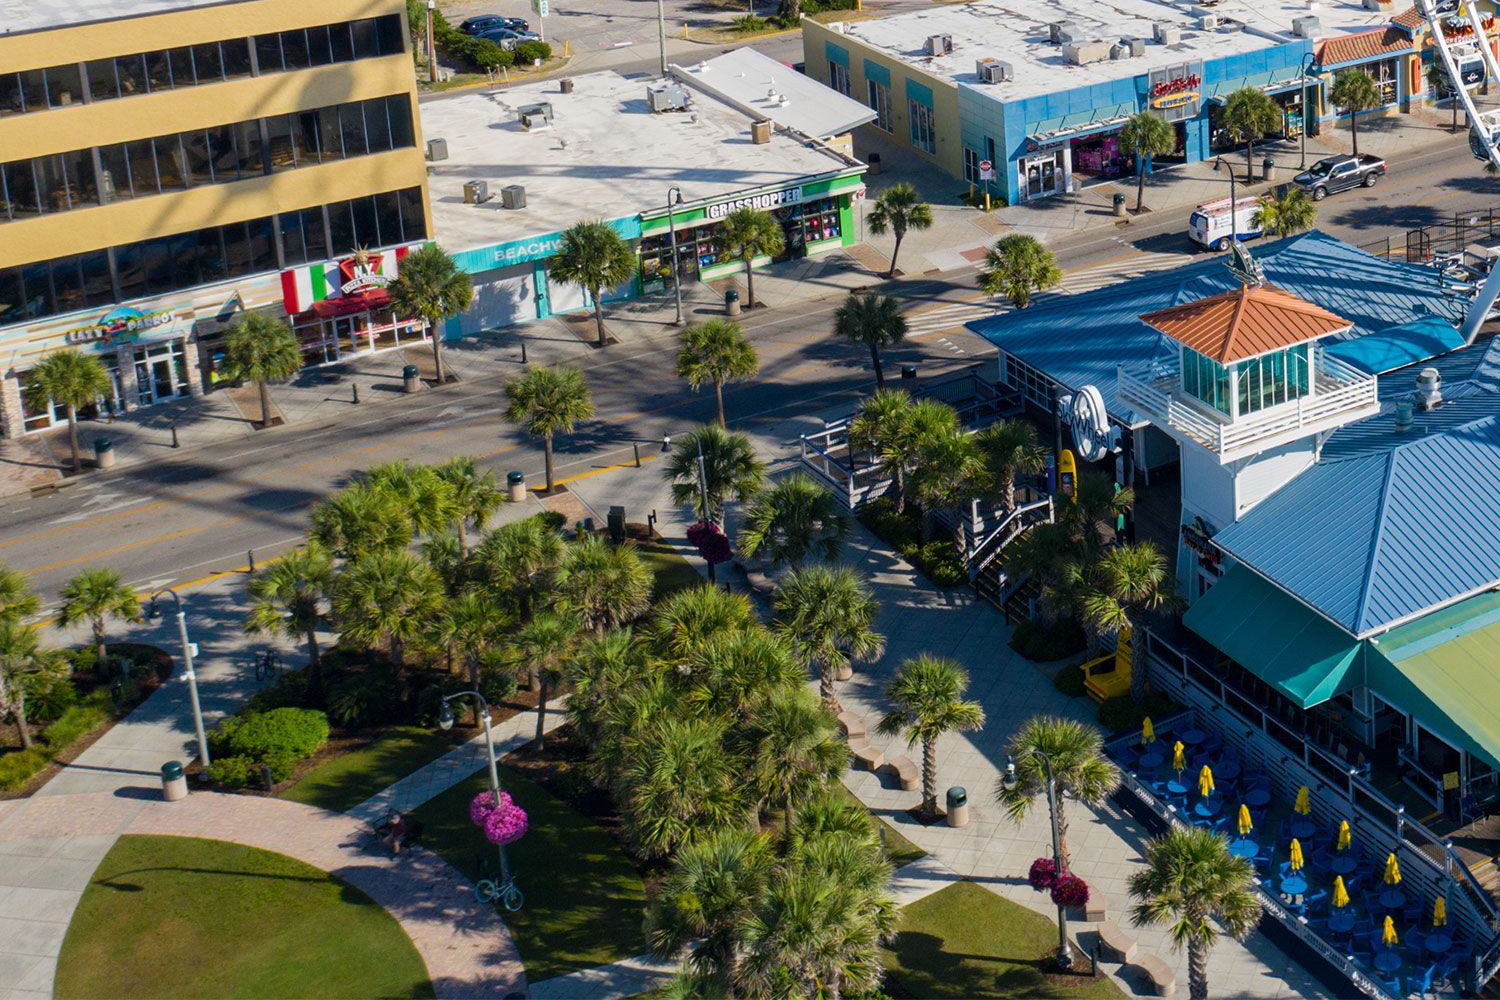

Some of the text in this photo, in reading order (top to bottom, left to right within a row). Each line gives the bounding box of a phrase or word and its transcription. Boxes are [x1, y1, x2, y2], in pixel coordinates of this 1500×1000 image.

[709, 187, 801, 219] GRASSHOPPER
[494, 239, 563, 262] BEACHW
[68, 309, 177, 343] LAZY PARROT
